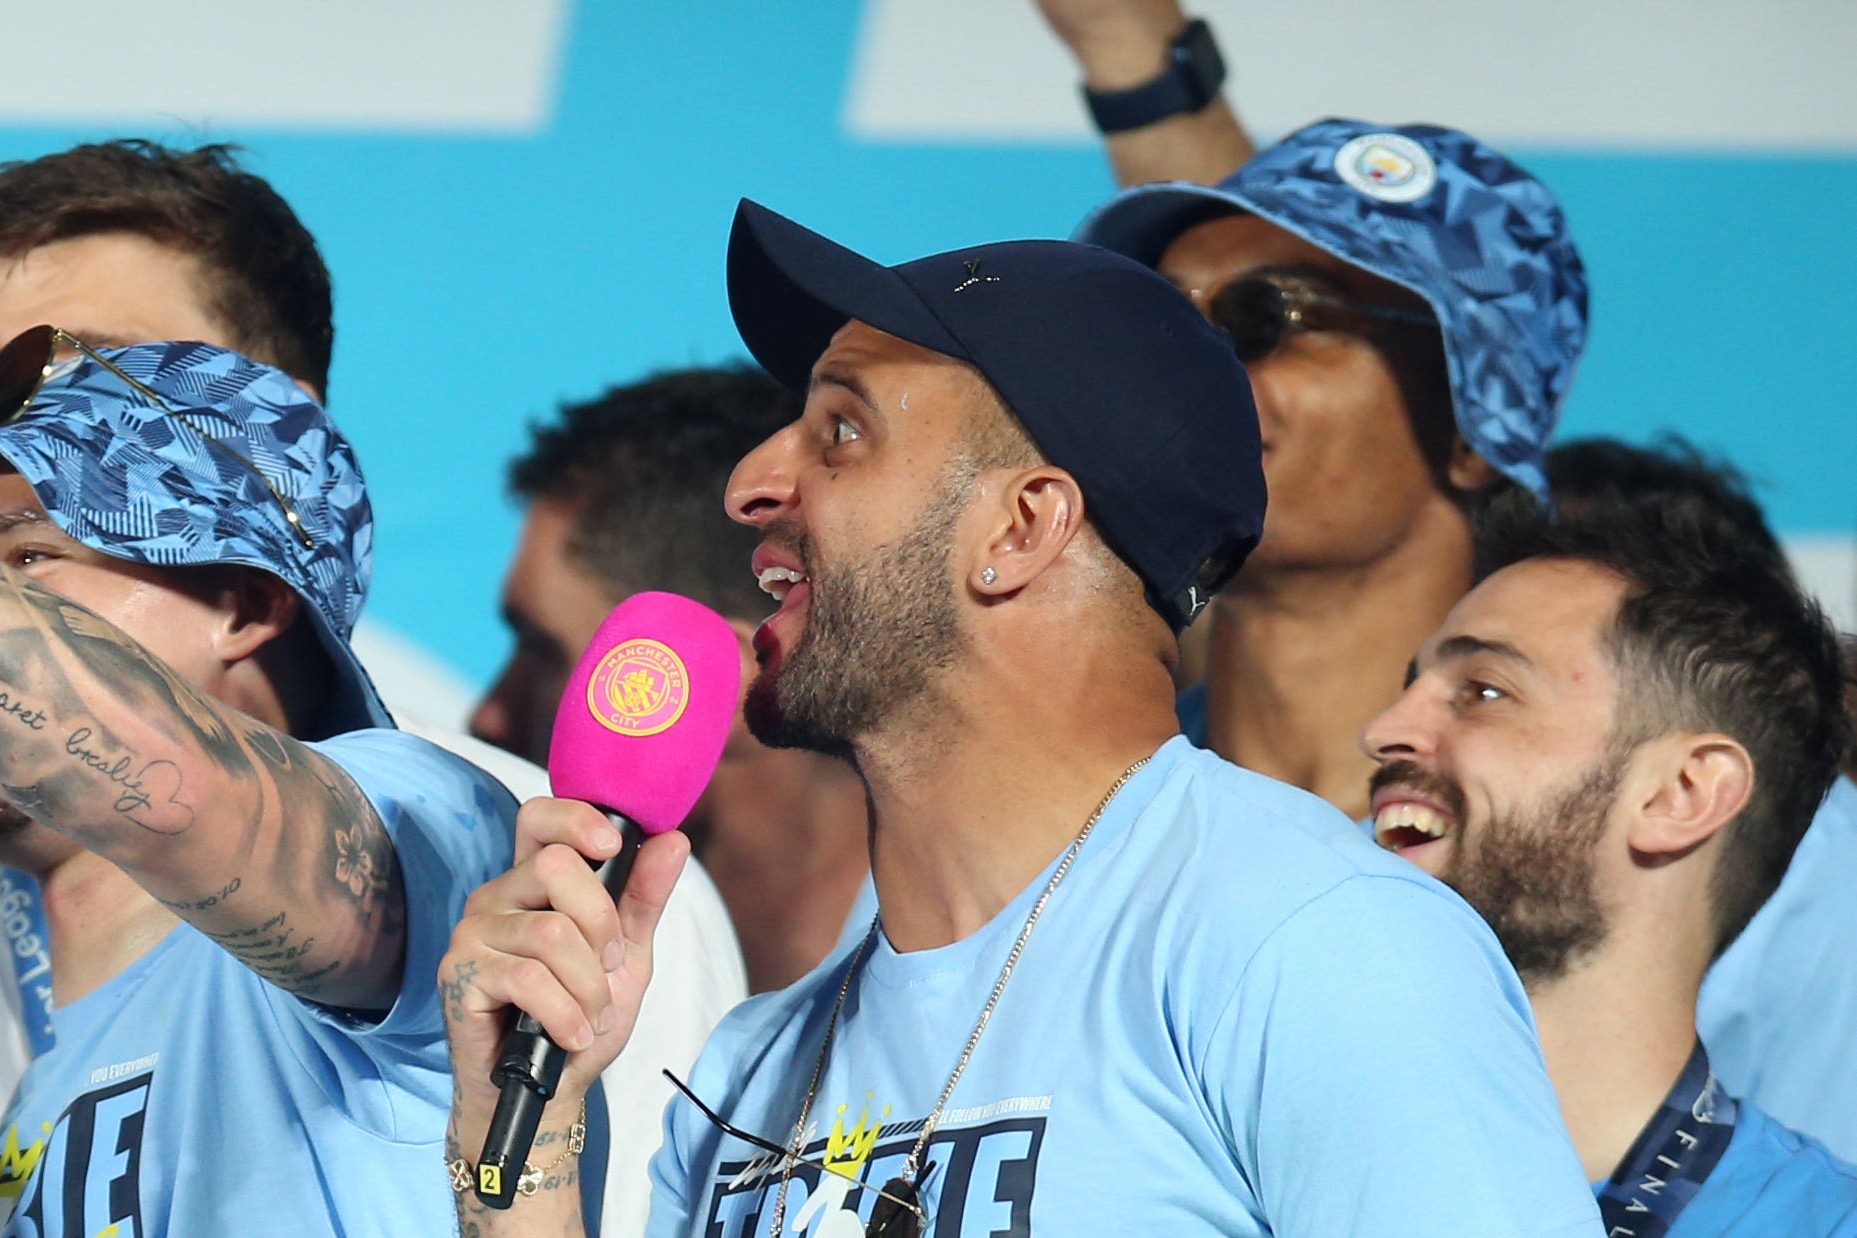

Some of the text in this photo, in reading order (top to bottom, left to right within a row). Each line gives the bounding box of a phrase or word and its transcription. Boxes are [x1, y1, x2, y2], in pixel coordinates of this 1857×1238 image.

[606, 646, 682, 689] MANCHESTER
[610, 712, 640, 729] CITY
[994, 1095, 1053, 1115] EVERYWHERE
[483, 1168, 495, 1190] 2
